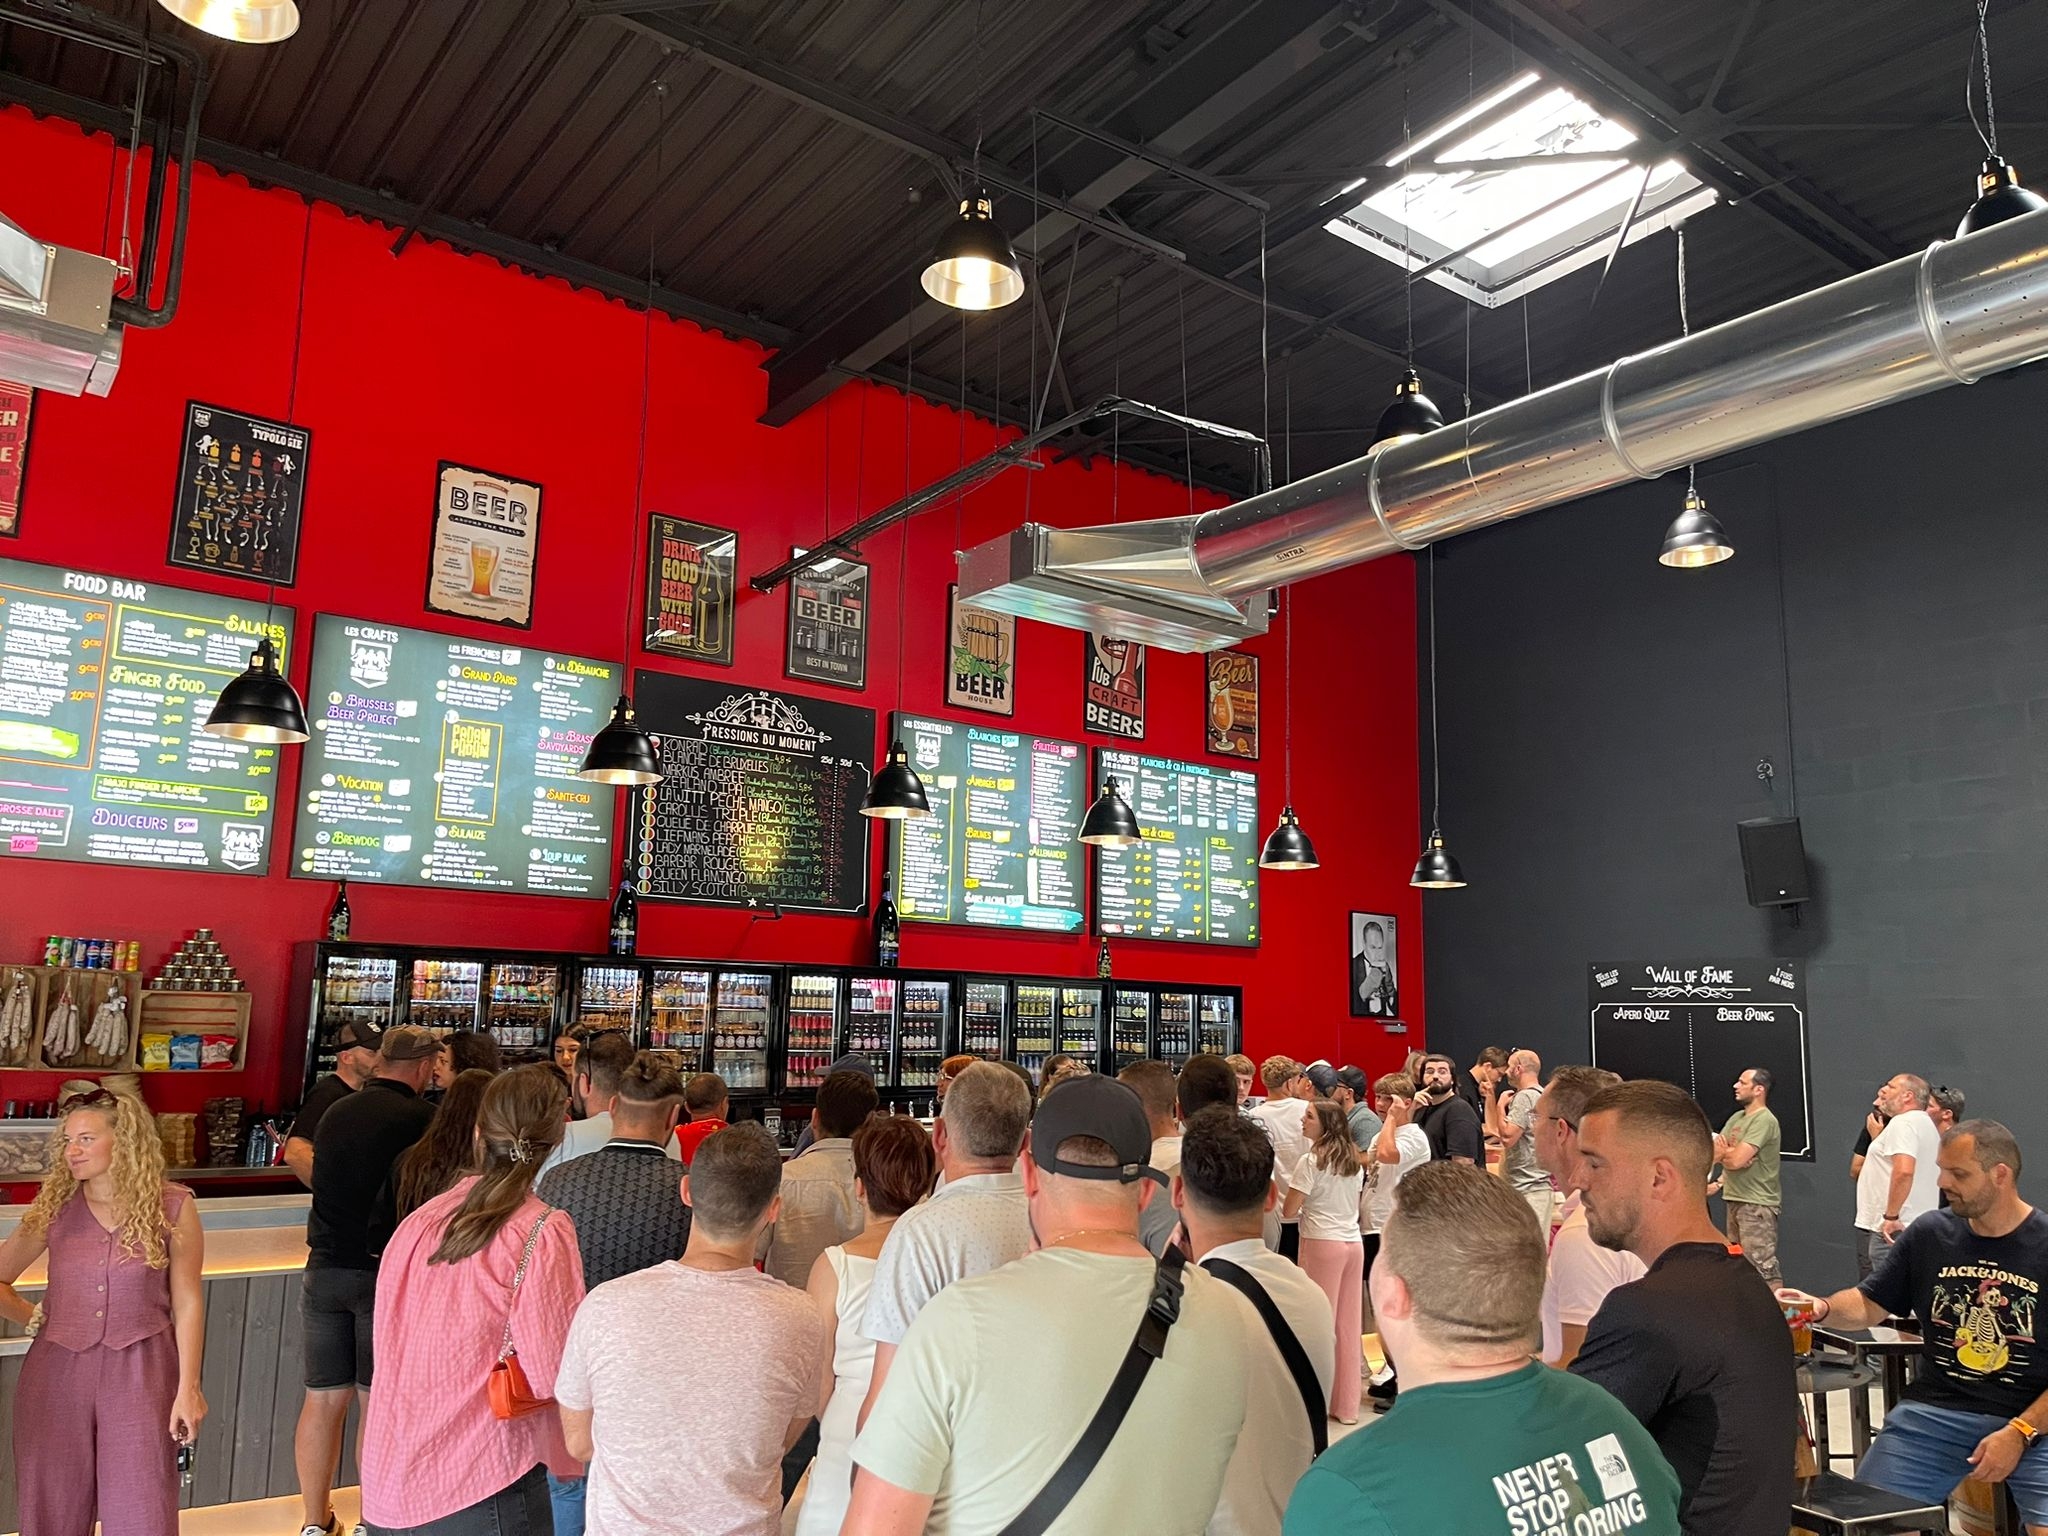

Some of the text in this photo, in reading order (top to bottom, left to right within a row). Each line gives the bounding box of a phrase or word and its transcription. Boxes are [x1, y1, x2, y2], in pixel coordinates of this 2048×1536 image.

[450, 486, 528, 525] BEER
[662, 539, 702, 563] DRINK
[662, 557, 699, 584] GOOD
[63, 572, 147, 602] FOOD BAR
[660, 578, 693, 602] BEER
[659, 597, 692, 616] WITH
[802, 600, 856, 626] BEER
[224, 614, 286, 639] SALADES
[658, 611, 692, 635] GOOD
[344, 625, 399, 644] LES CRAFTS
[448, 644, 461, 654] LES
[567, 660, 610, 679] DÉBAUCHE
[806, 655, 821, 668] BEST
[830, 661, 848, 673] TOWN
[1091, 656, 1111, 687] PUB
[1210, 657, 1253, 690] Beer
[109, 665, 206, 694] FINGER FOOD
[462, 666, 518, 686] GRAND PARIS
[956, 673, 1005, 700] BEER
[345, 694, 395, 712] BRUSSELS
[967, 695, 993, 705] HOUSE
[1092, 687, 1138, 712] CRAFT
[327, 706, 399, 726] BEER PROJECT
[1087, 702, 1144, 739] BEERS
[663, 736, 708, 754] KONRAD
[702, 722, 817, 752] PRESSIONS DU MOMENT
[537, 739, 584, 755] SAVOYARDS
[662, 763, 700, 779] MARKUS
[663, 749, 707, 767] BLANCHE
[708, 754, 722, 768] DE
[723, 756, 769, 774] BRUXELLES
[336, 774, 384, 792] VOCATION
[660, 775, 718, 793] ZEALAND
[718, 781, 743, 797] IPA
[35, 807, 65, 818] DALLE
[712, 807, 758, 823] TRIPLE
[748, 797, 782, 814] MANGO
[92, 807, 168, 831] DOUCEURS
[656, 815, 693, 831] QUEUE
[696, 818, 712, 832] DE
[713, 820, 757, 835] CHARRUE
[331, 831, 380, 848] BREWDOG
[449, 825, 487, 840] SULAUZE
[656, 828, 746, 847] LIEFMANS PEACH
[562, 853, 587, 864] BLANC
[656, 841, 682, 854] LADY
[683, 843, 737, 858] MARMELADE
[655, 854, 698, 869] BARBAR
[703, 855, 740, 871] ROUGE
[653, 866, 688, 880] QUEEN
[691, 868, 747, 885] FLAMINGO
[651, 880, 738, 898] SILLY SCOTCH
[1646, 966, 1733, 984] WALL OF FAME
[1613, 1007, 1670, 1022] APERO QUIZZ
[1716, 1007, 1775, 1022] BEER PONG
[1938, 1266, 2039, 1293] JACK&JONES
[1492, 1452, 1579, 1507] NEVER
[1506, 1489, 1571, 1536] STOP
